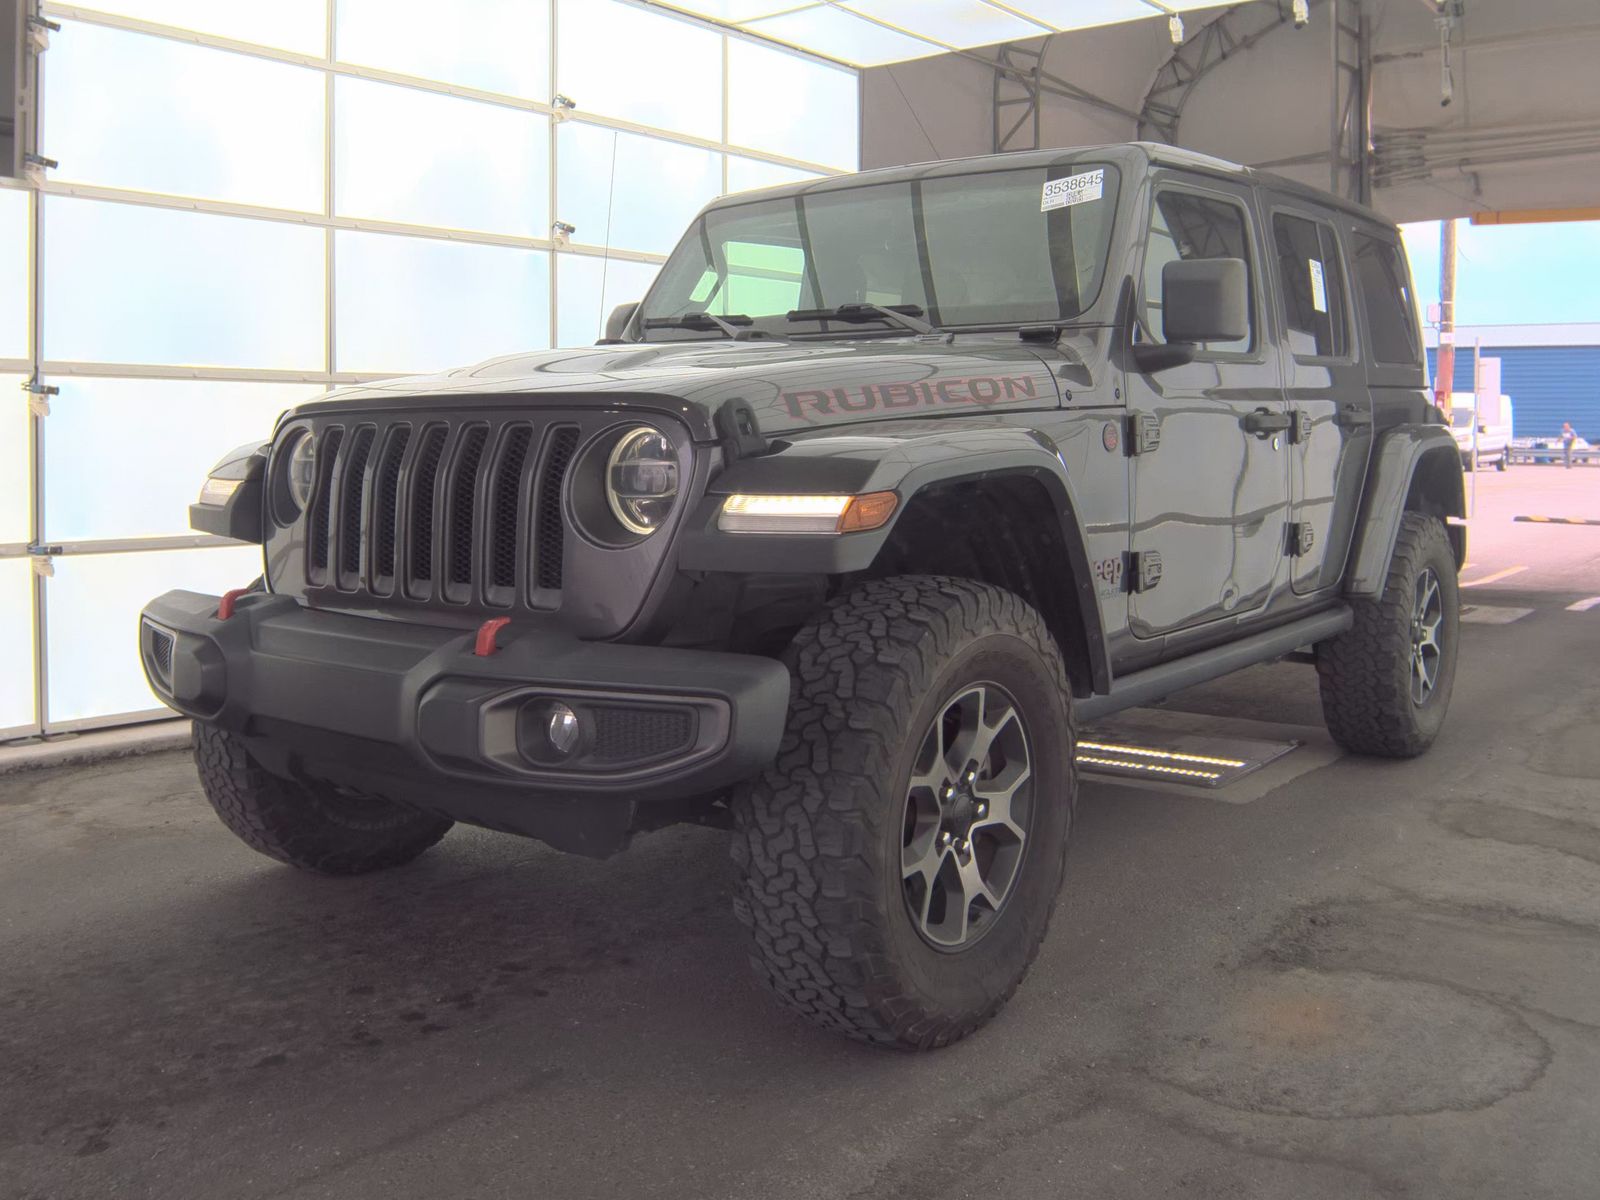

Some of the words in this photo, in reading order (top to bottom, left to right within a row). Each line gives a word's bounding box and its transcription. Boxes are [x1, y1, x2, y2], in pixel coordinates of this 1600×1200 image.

[1045, 173, 1103, 196] 3538645
[783, 375, 1036, 418] RUBICON
[1092, 557, 1123, 584] eep
